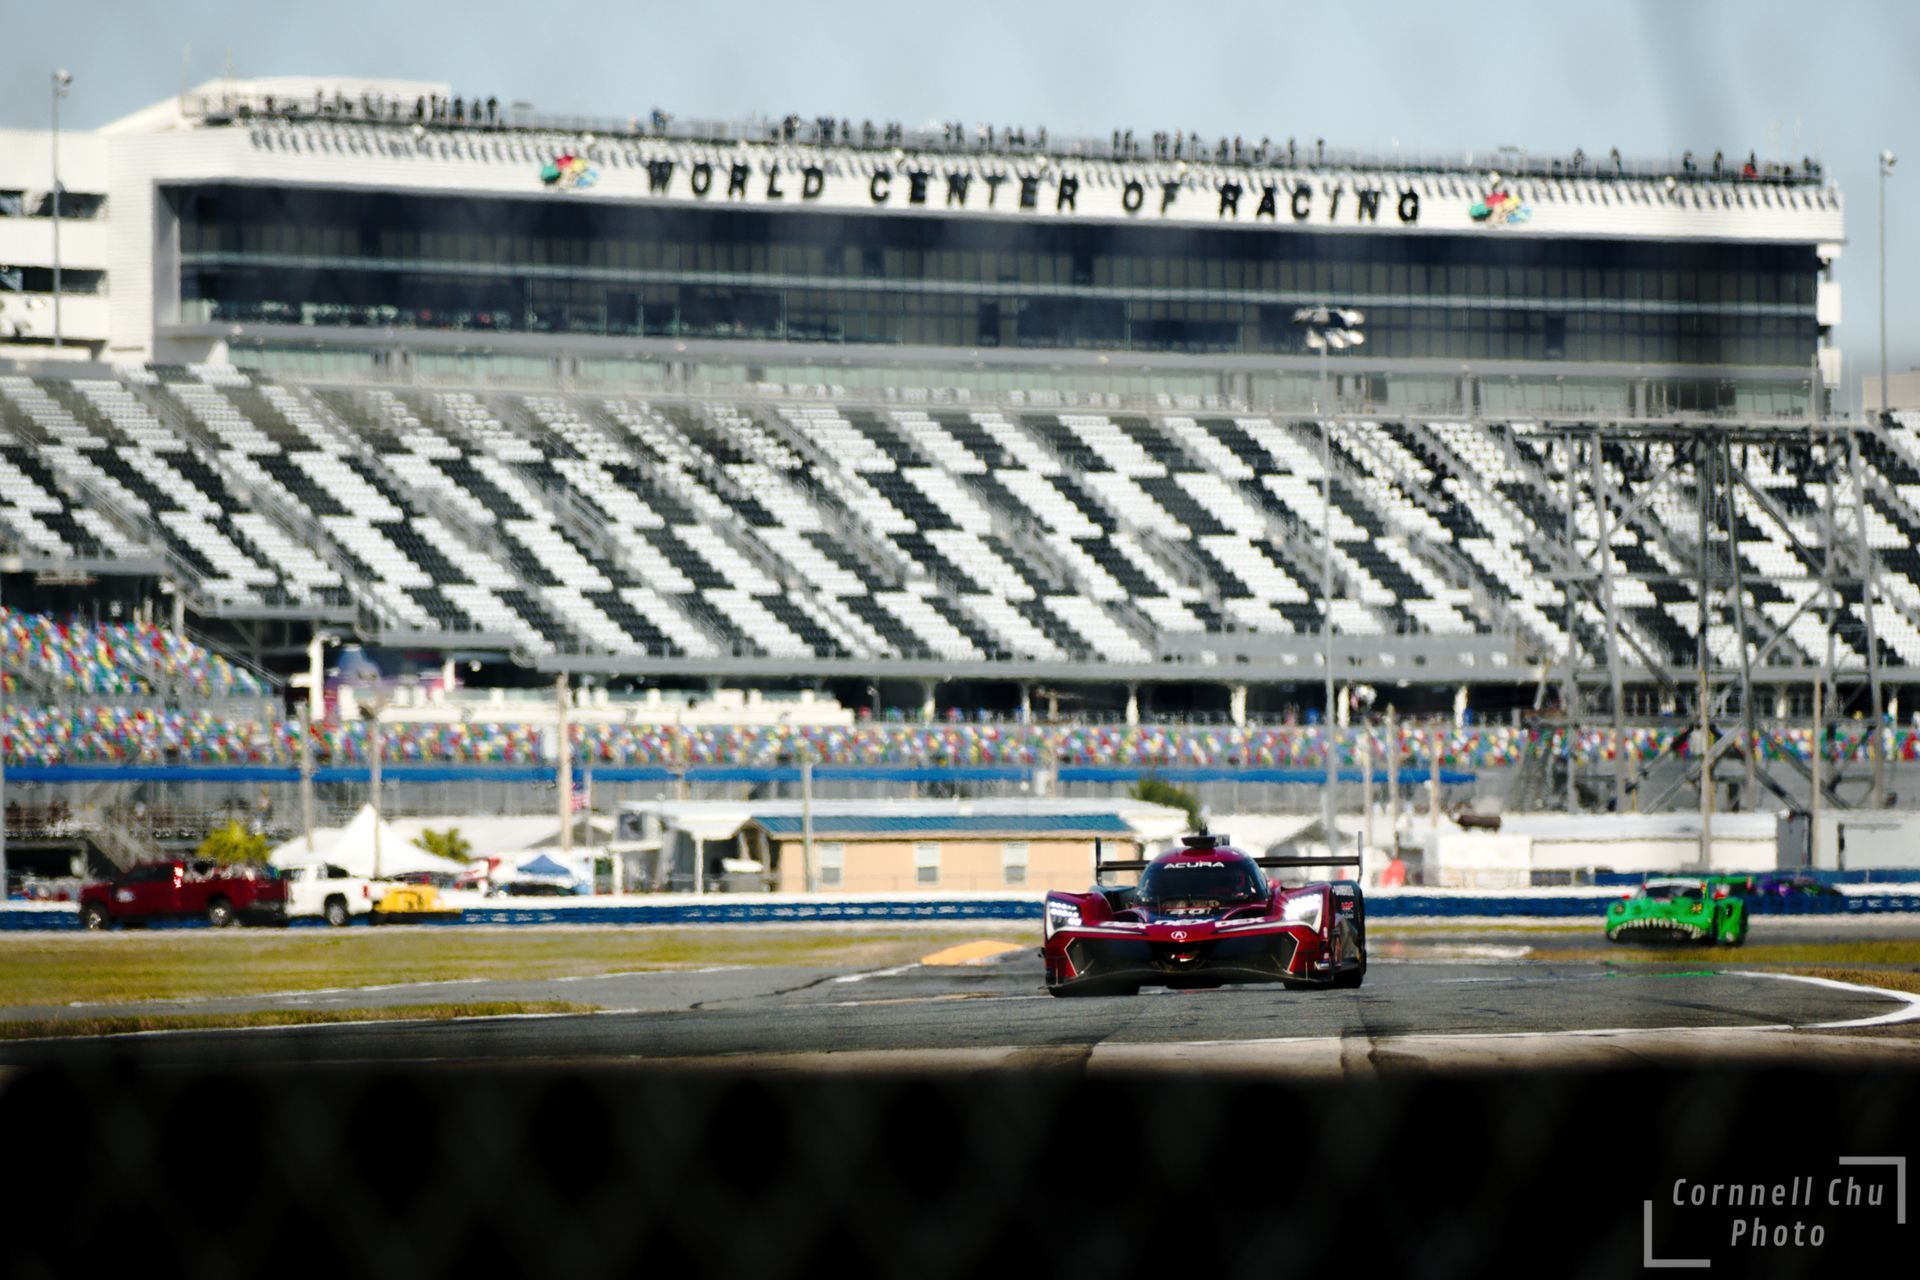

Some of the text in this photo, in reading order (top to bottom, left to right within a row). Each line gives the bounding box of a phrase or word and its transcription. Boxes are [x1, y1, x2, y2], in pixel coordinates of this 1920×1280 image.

[648, 159, 1420, 223] WORLD CENTER OF RACING
[1164, 861, 1225, 869] ACURA
[1215, 917, 1265, 928] DEX
